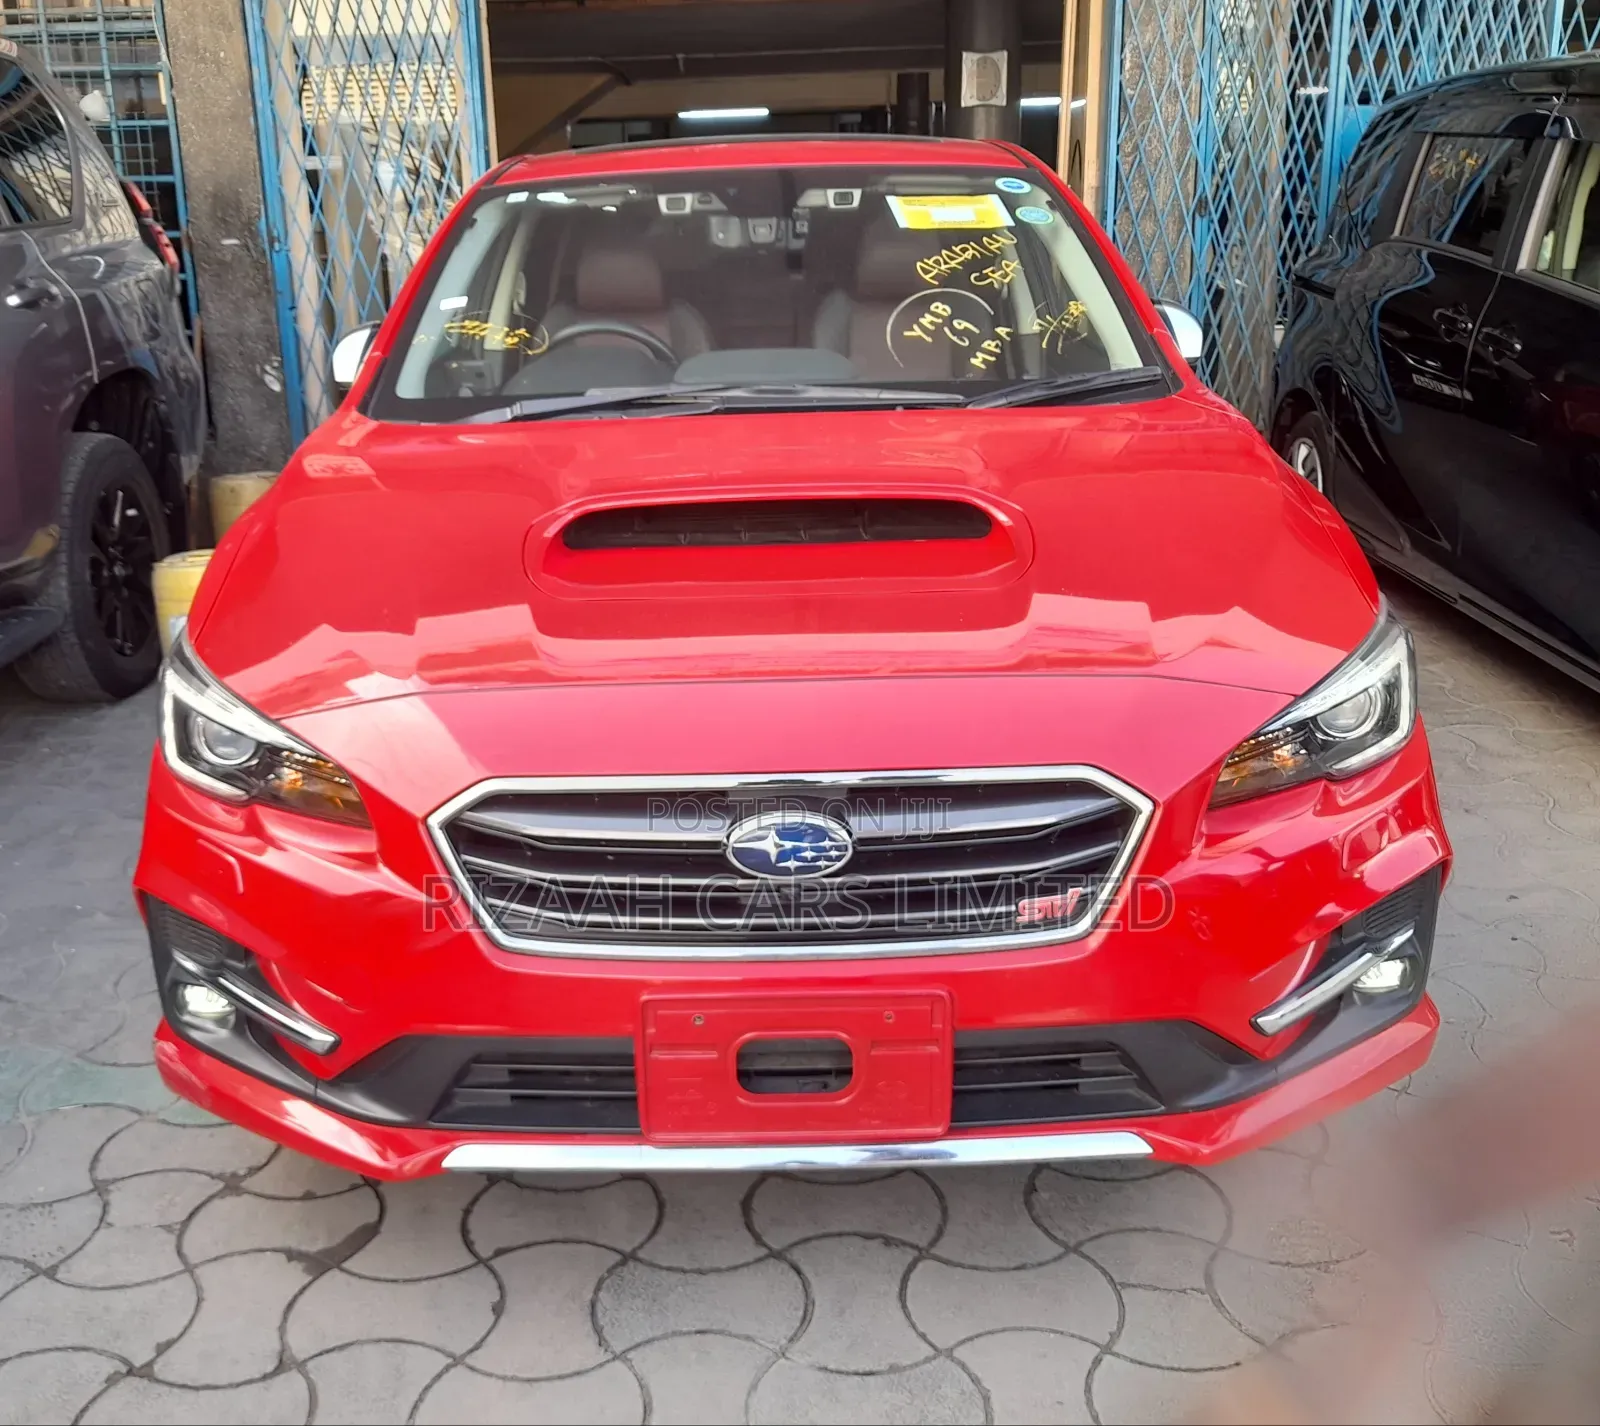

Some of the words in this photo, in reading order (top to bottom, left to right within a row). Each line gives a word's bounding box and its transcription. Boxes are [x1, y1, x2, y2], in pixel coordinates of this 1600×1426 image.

[970, 259, 1024, 289] SEA
[903, 301, 952, 343] YMB
[969, 326, 1014, 370] MBA
